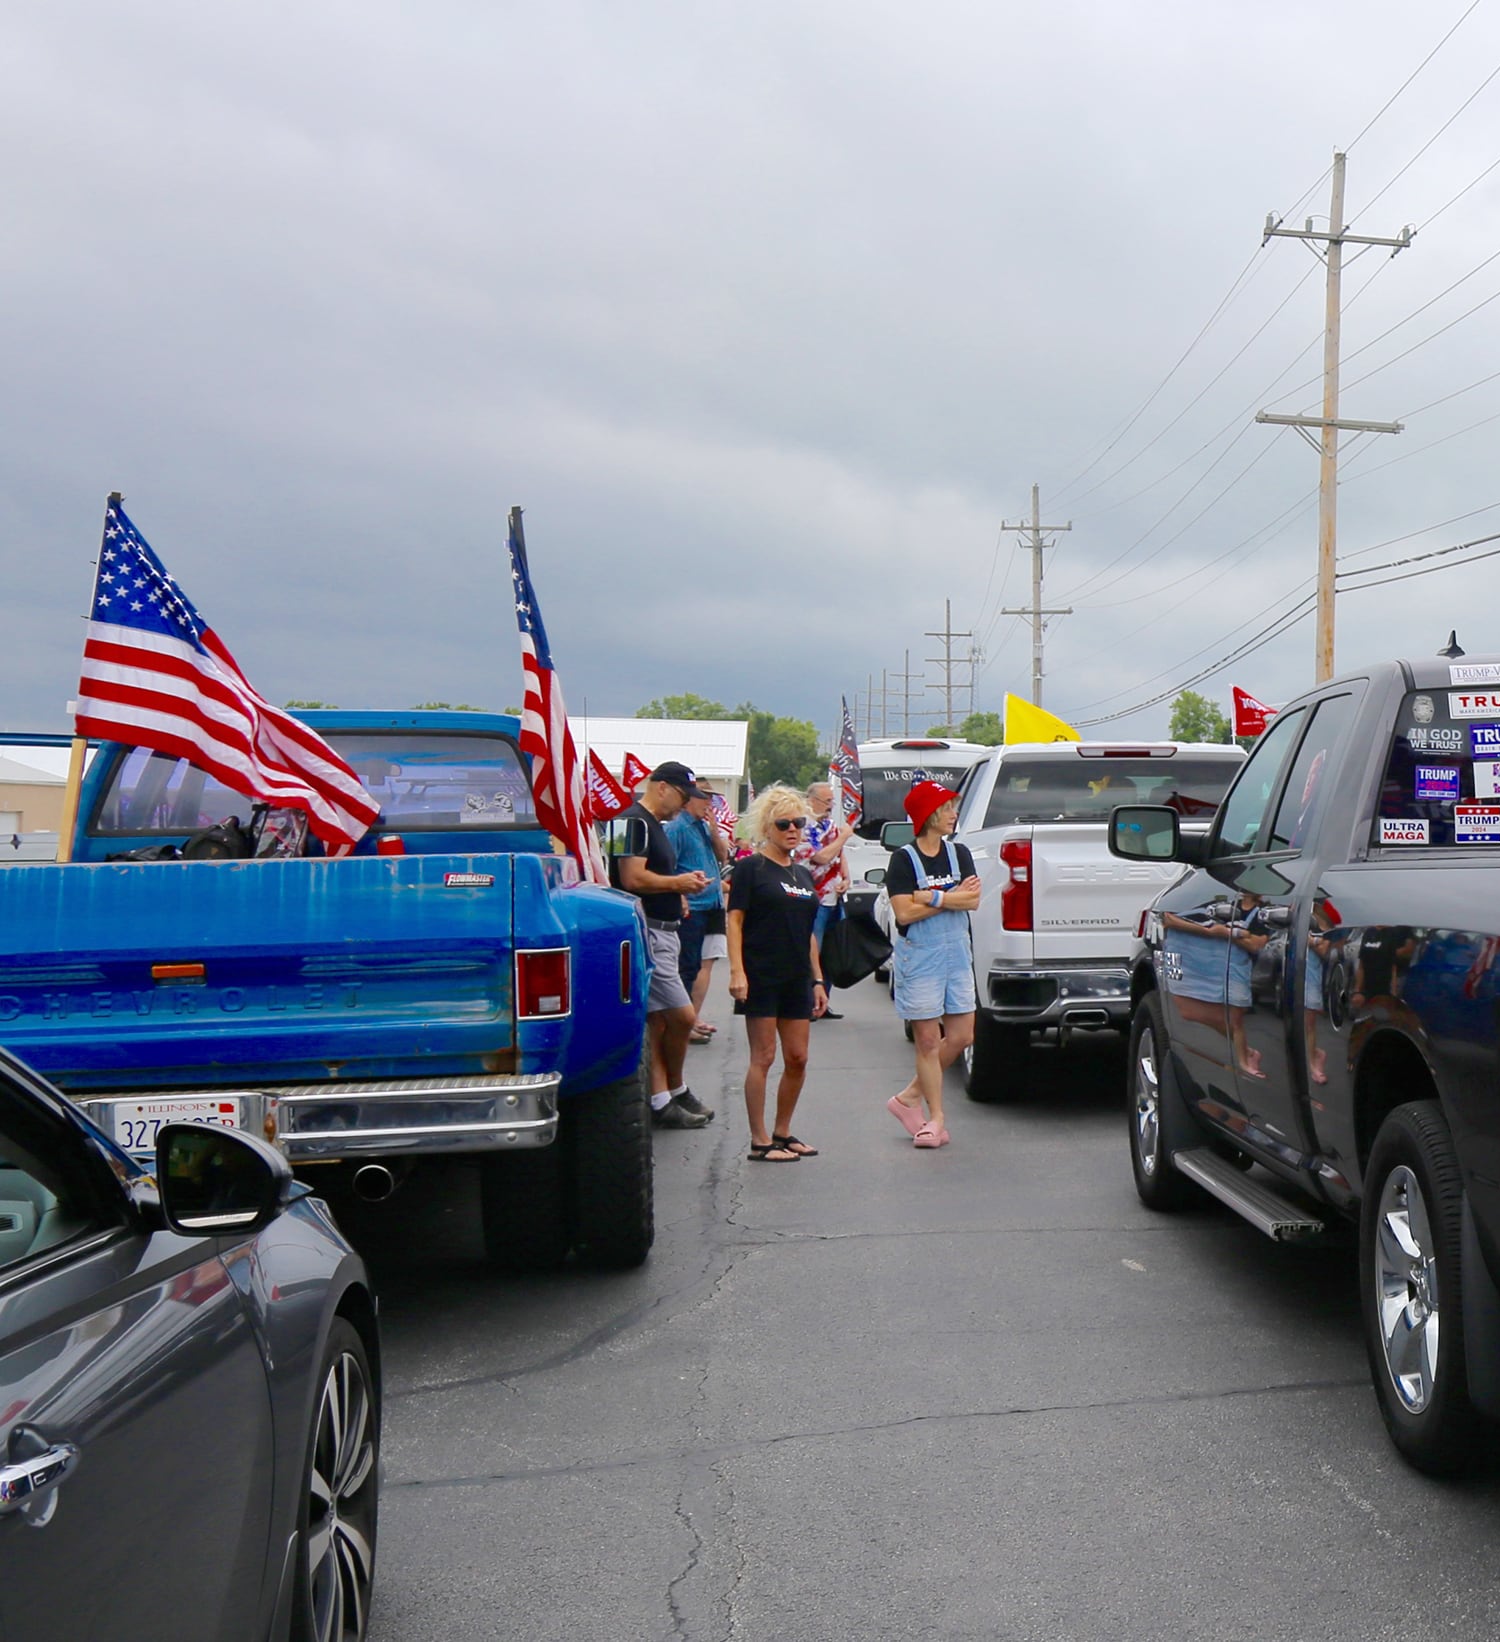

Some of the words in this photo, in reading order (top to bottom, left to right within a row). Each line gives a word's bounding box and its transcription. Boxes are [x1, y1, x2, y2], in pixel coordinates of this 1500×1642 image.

[1411, 728, 1428, 739] IN
[1430, 728, 1462, 740] GOD
[1410, 739, 1428, 749] WE
[1431, 740, 1463, 750] TRUST
[882, 770, 899, 781] We
[1419, 768, 1457, 781] TRUMP
[1458, 816, 1500, 825] TRUMP
[1383, 822, 1425, 831] ULTRA
[1383, 831, 1425, 840] MAGA
[1040, 918, 1120, 926] SILVERADO
[0, 982, 364, 1021] CHEVROLET
[148, 1102, 208, 1114] ILLINOIS
